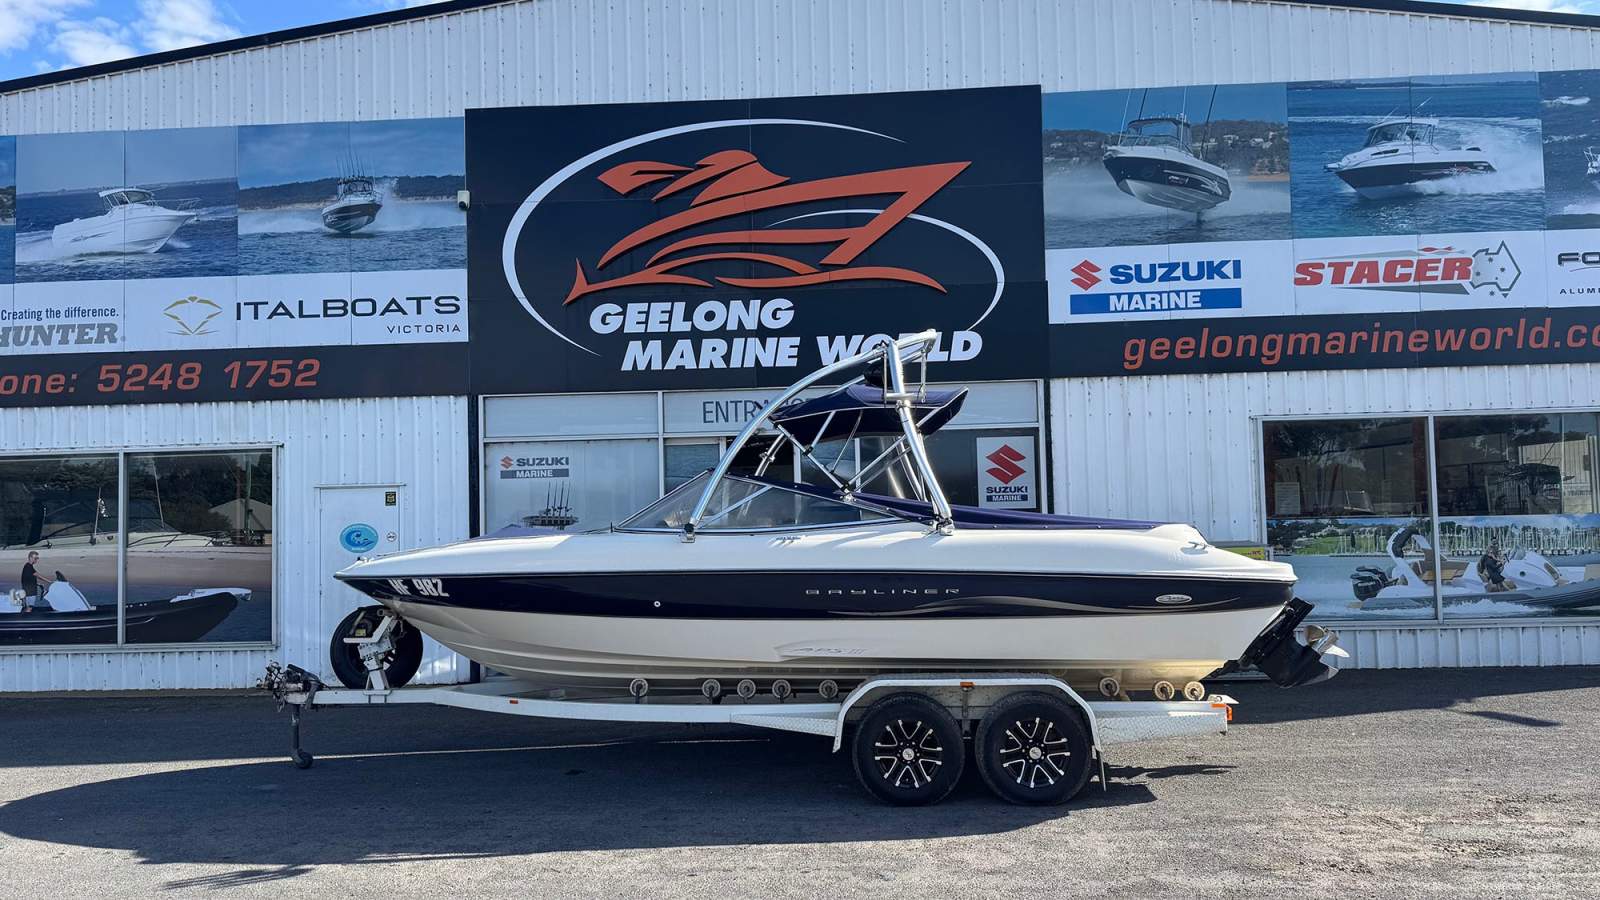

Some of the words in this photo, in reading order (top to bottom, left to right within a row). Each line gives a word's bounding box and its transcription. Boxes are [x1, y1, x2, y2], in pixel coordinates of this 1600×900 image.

[1109, 260, 1241, 284] SUZUKI
[1294, 256, 1473, 286] STACER
[1559, 286, 1600, 294] ALUM
[236, 295, 461, 321] ITALBOATS
[1109, 291, 1202, 312] MARINE
[1, 308, 42, 321] Creating
[45, 307, 61, 319] the
[64, 306, 119, 318] difference.
[589, 298, 794, 334] GEELONG
[387, 324, 461, 334] VICTORIA
[620, 336, 800, 371] MARINE
[97, 362, 202, 392] 5248
[224, 358, 321, 389] 1752
[516, 457, 569, 467] SUZUKI
[516, 470, 553, 478] MARINE
[986, 486, 1028, 494] SUZUKI
[992, 494, 1022, 502] MARINE
[411, 577, 450, 597] 982
